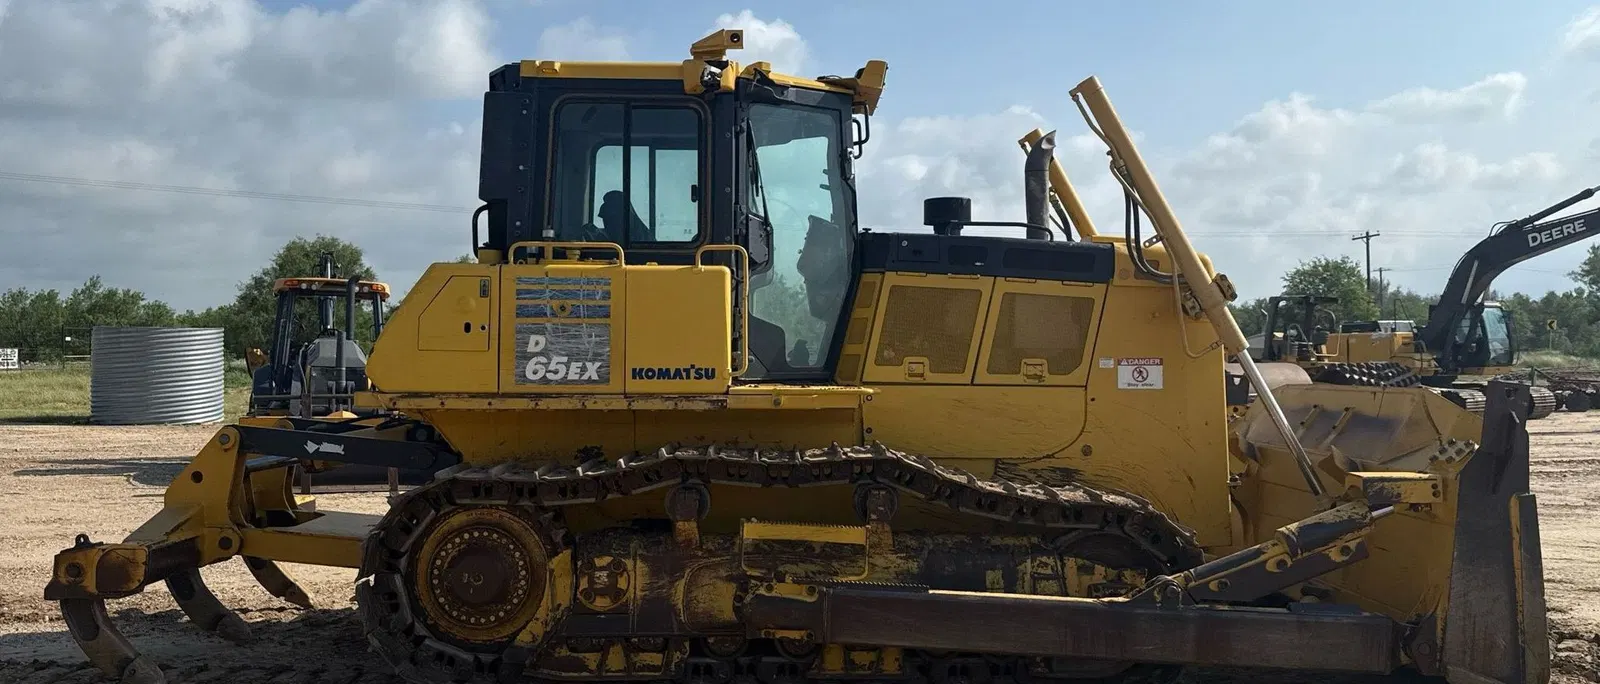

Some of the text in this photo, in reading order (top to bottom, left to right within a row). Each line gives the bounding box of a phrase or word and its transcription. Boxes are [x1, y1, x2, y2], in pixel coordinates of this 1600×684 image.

[1527, 219, 1587, 247] DEERE
[526, 335, 546, 353] D
[525, 356, 602, 381] 65EX
[631, 364, 716, 381] KOMATSU
